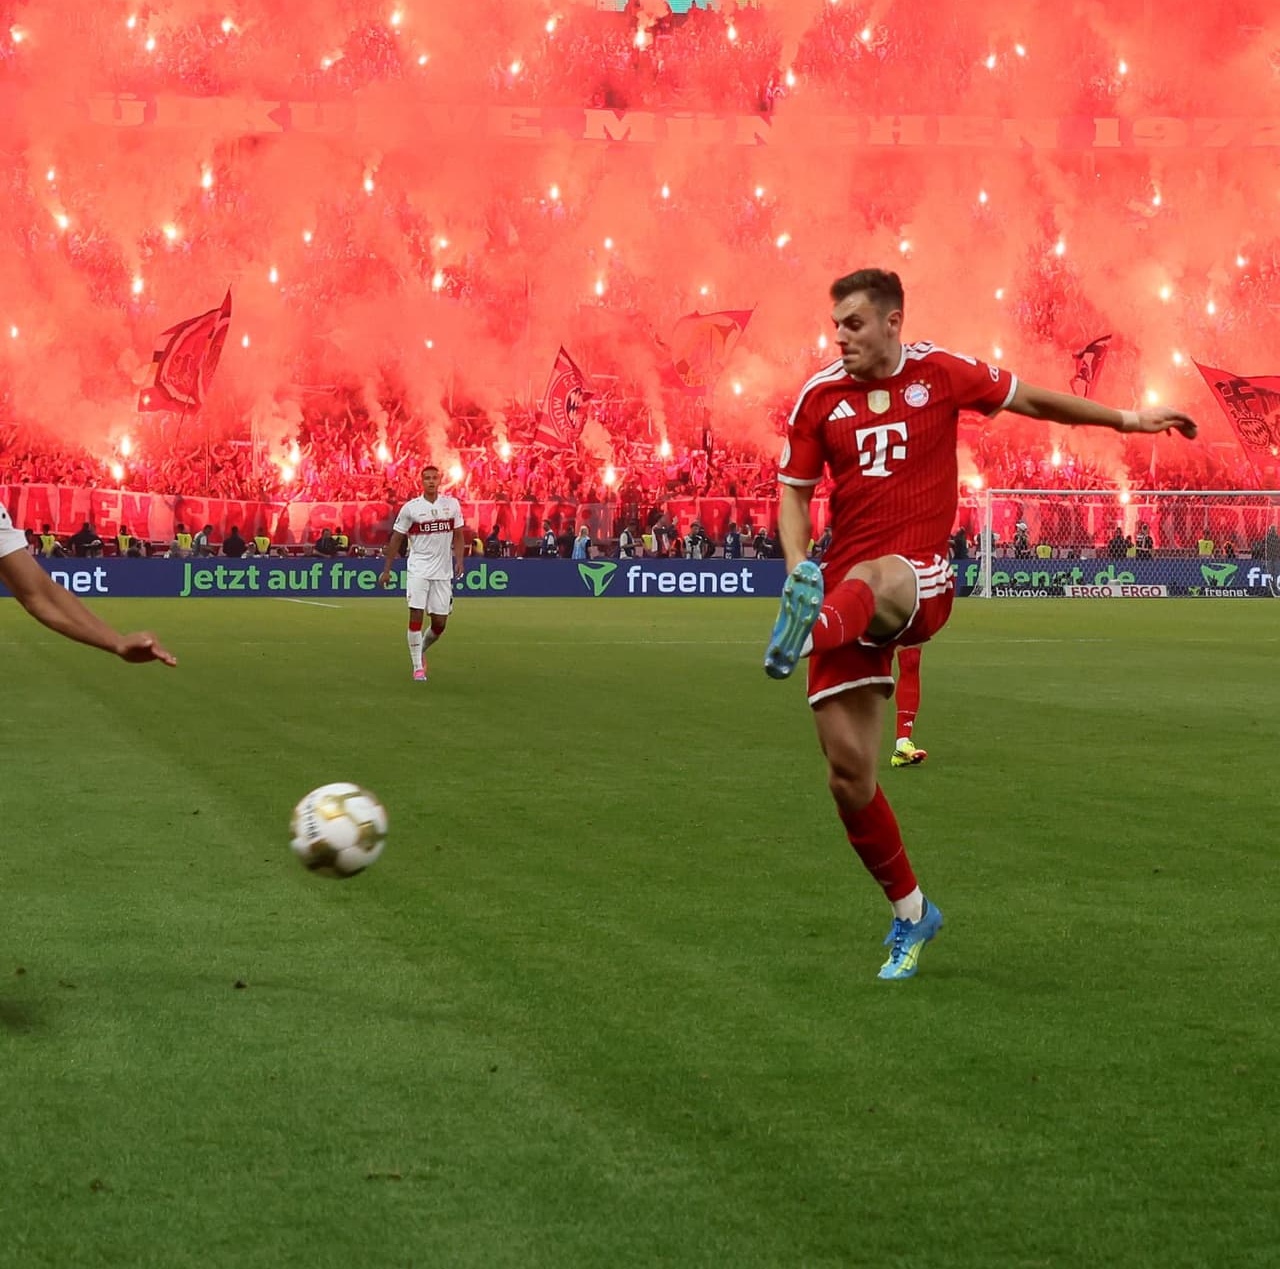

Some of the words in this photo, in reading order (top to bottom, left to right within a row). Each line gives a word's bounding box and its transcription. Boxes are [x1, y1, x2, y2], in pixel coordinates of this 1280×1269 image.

[180, 563, 260, 597] Jetzt
[268, 563, 322, 590] auf
[626, 566, 755, 593] freenet
[996, 586, 1049, 598] bitvavo
[1071, 586, 1113, 598] ERGO
[1121, 586, 1162, 598] ERGO
[1204, 587, 1250, 597] freenet
